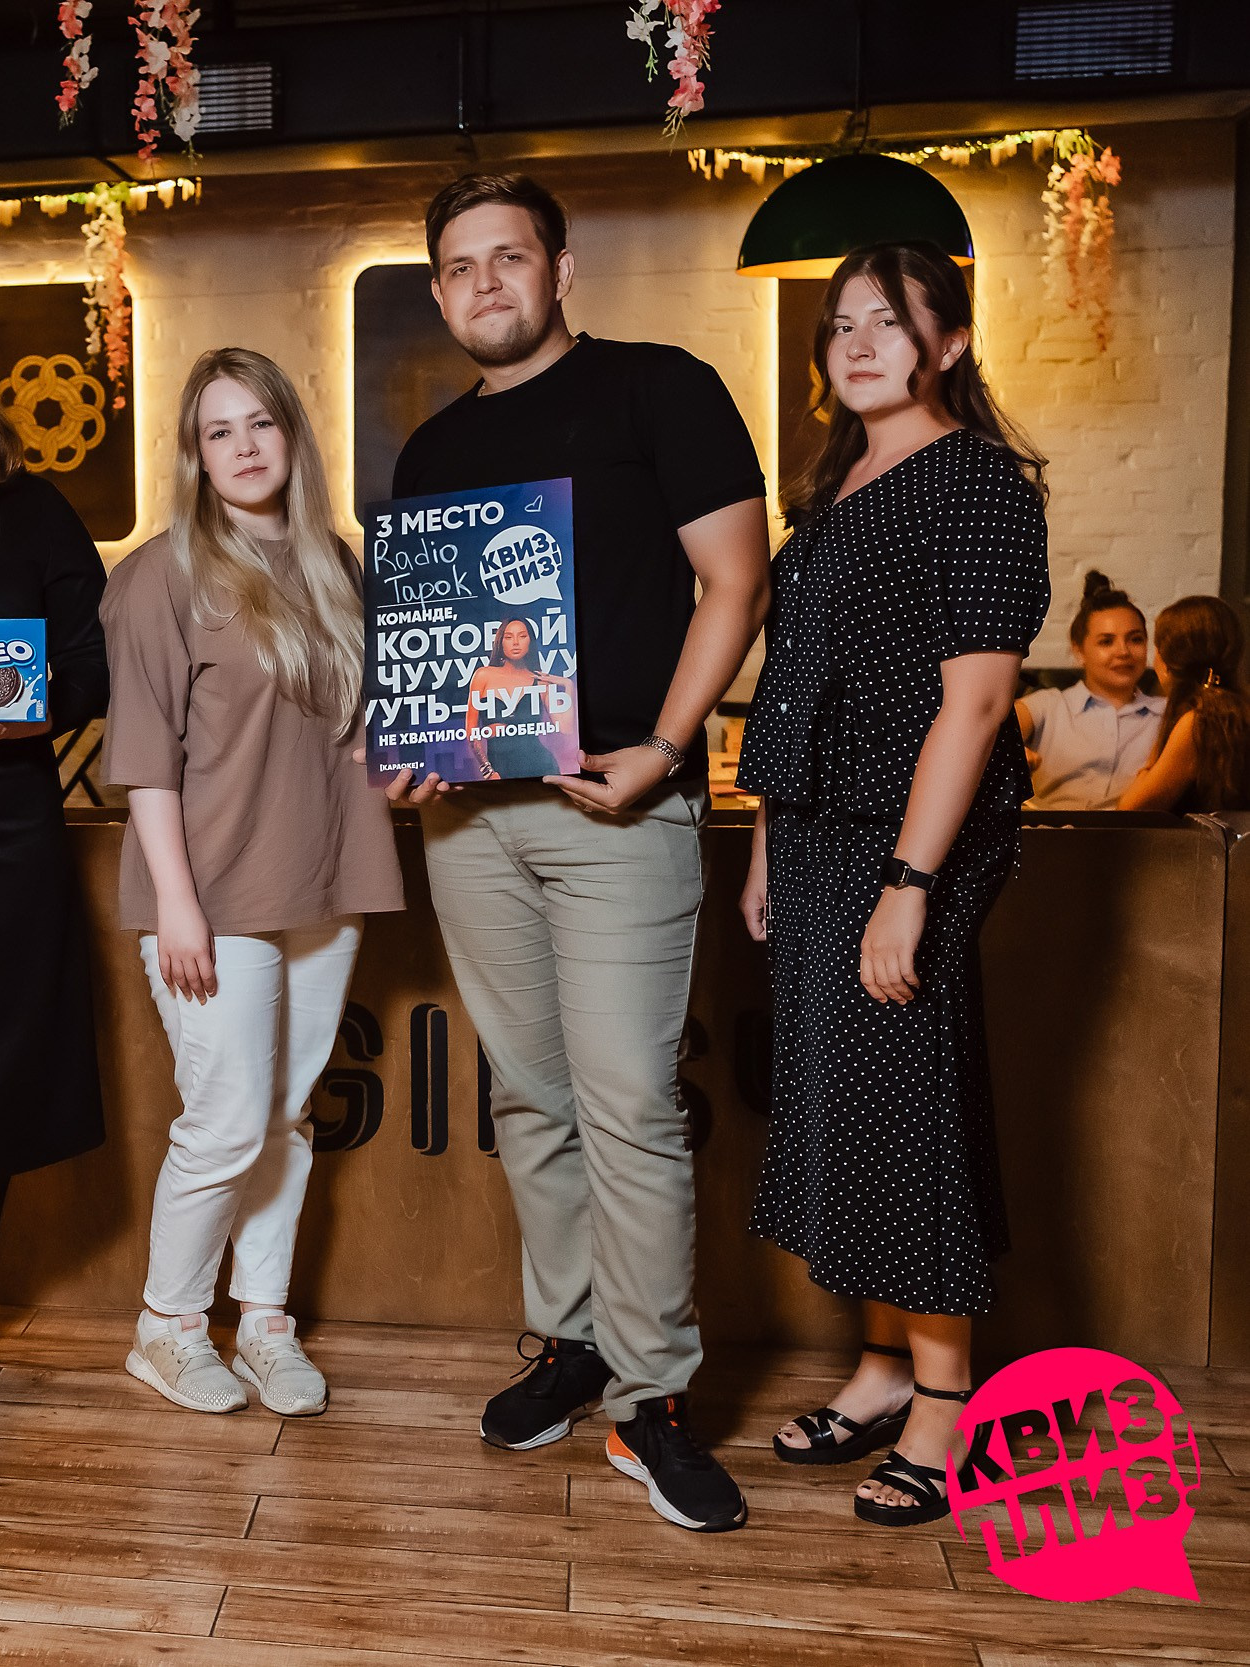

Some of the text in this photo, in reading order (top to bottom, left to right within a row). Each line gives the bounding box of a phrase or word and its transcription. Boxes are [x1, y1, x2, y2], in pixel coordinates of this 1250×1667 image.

[376, 501, 505, 538] 3 МЕСТО
[374, 538, 459, 575] Radio
[384, 564, 473, 610] Tapok
[376, 606, 458, 627] КОМАНДЕ,
[377, 607, 568, 662] КОТОРЙ
[378, 721, 560, 747] НЕ ХВАТИЛО ДО ПОБЕДЫ
